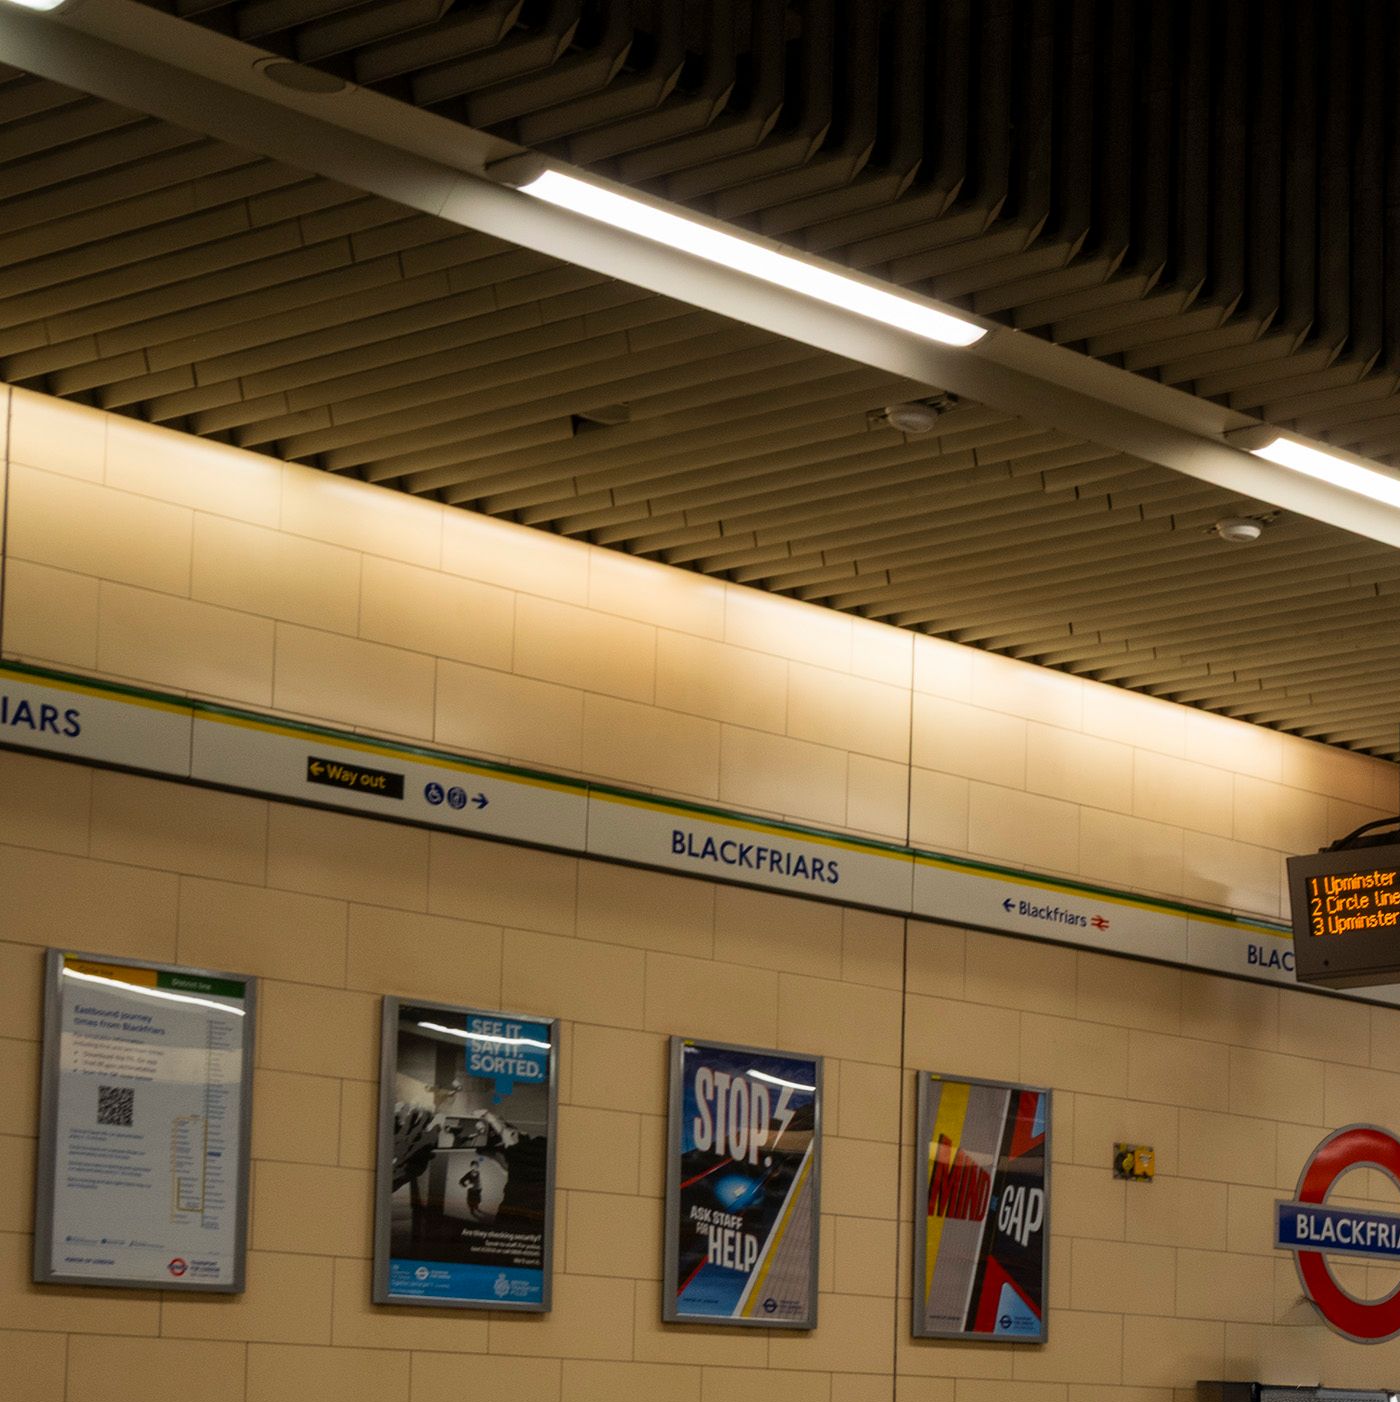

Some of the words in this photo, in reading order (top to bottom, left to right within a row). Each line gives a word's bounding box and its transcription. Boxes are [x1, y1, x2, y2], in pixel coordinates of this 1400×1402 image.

[326, 763, 358, 786] Way
[360, 774, 386, 789] out
[671, 830, 840, 884] BLACKFRIARS
[1311, 878, 1319, 896] 1
[1324, 870, 1397, 895] Upminster
[1019, 900, 1087, 928] Blackfriars
[1311, 897, 1322, 916] 2
[1326, 893, 1369, 914] Circle
[1374, 890, 1400, 907] line
[1312, 916, 1324, 936] 3
[1328, 910, 1400, 935] Upminster
[471, 1019, 503, 1037] SEE
[470, 1056, 544, 1078] SORTED.
[928, 1133, 991, 1222] MIND
[690, 1205, 712, 1222] ASK
[712, 1210, 743, 1230] STAFF
[998, 1184, 1044, 1247] GAP
[696, 1222, 709, 1235] FOR
[708, 1225, 758, 1273] HELP
